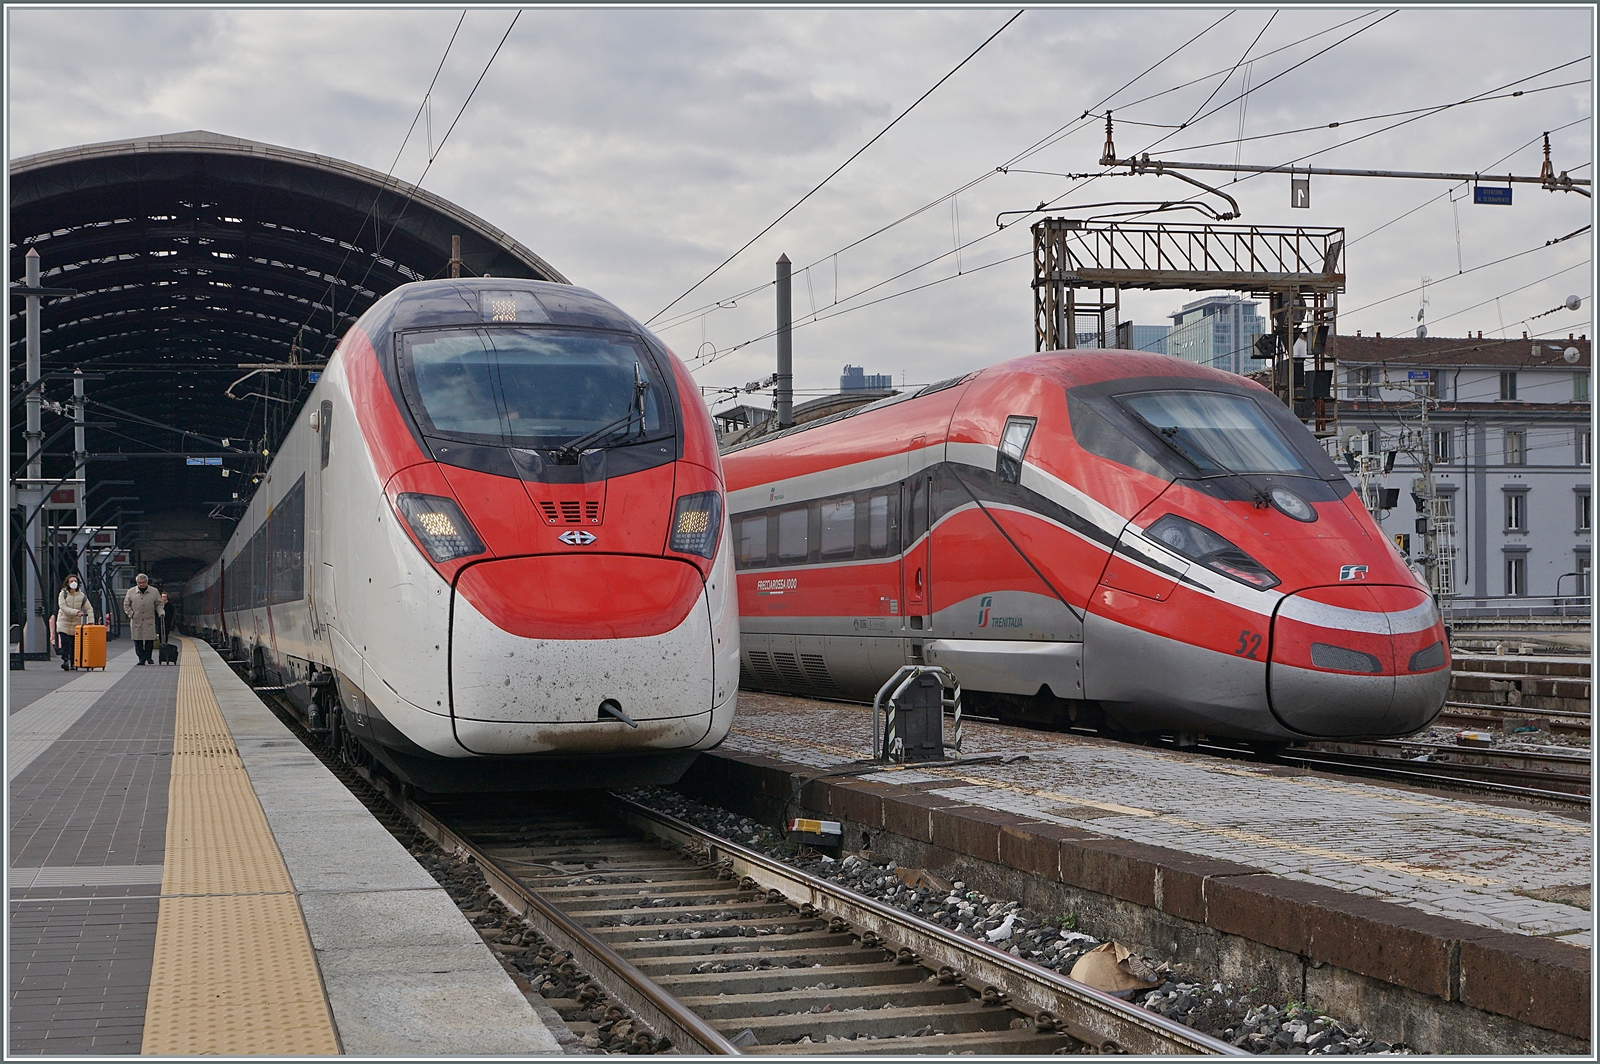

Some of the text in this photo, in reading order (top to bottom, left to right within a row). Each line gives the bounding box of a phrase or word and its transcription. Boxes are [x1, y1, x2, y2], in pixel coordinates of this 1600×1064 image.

[1396, 536, 1402, 546] 7
[757, 578, 797, 591] FRECCIAROSSA 1000
[991, 617, 1023, 628] TRENITALIA
[1235, 629, 1263, 659] 52
